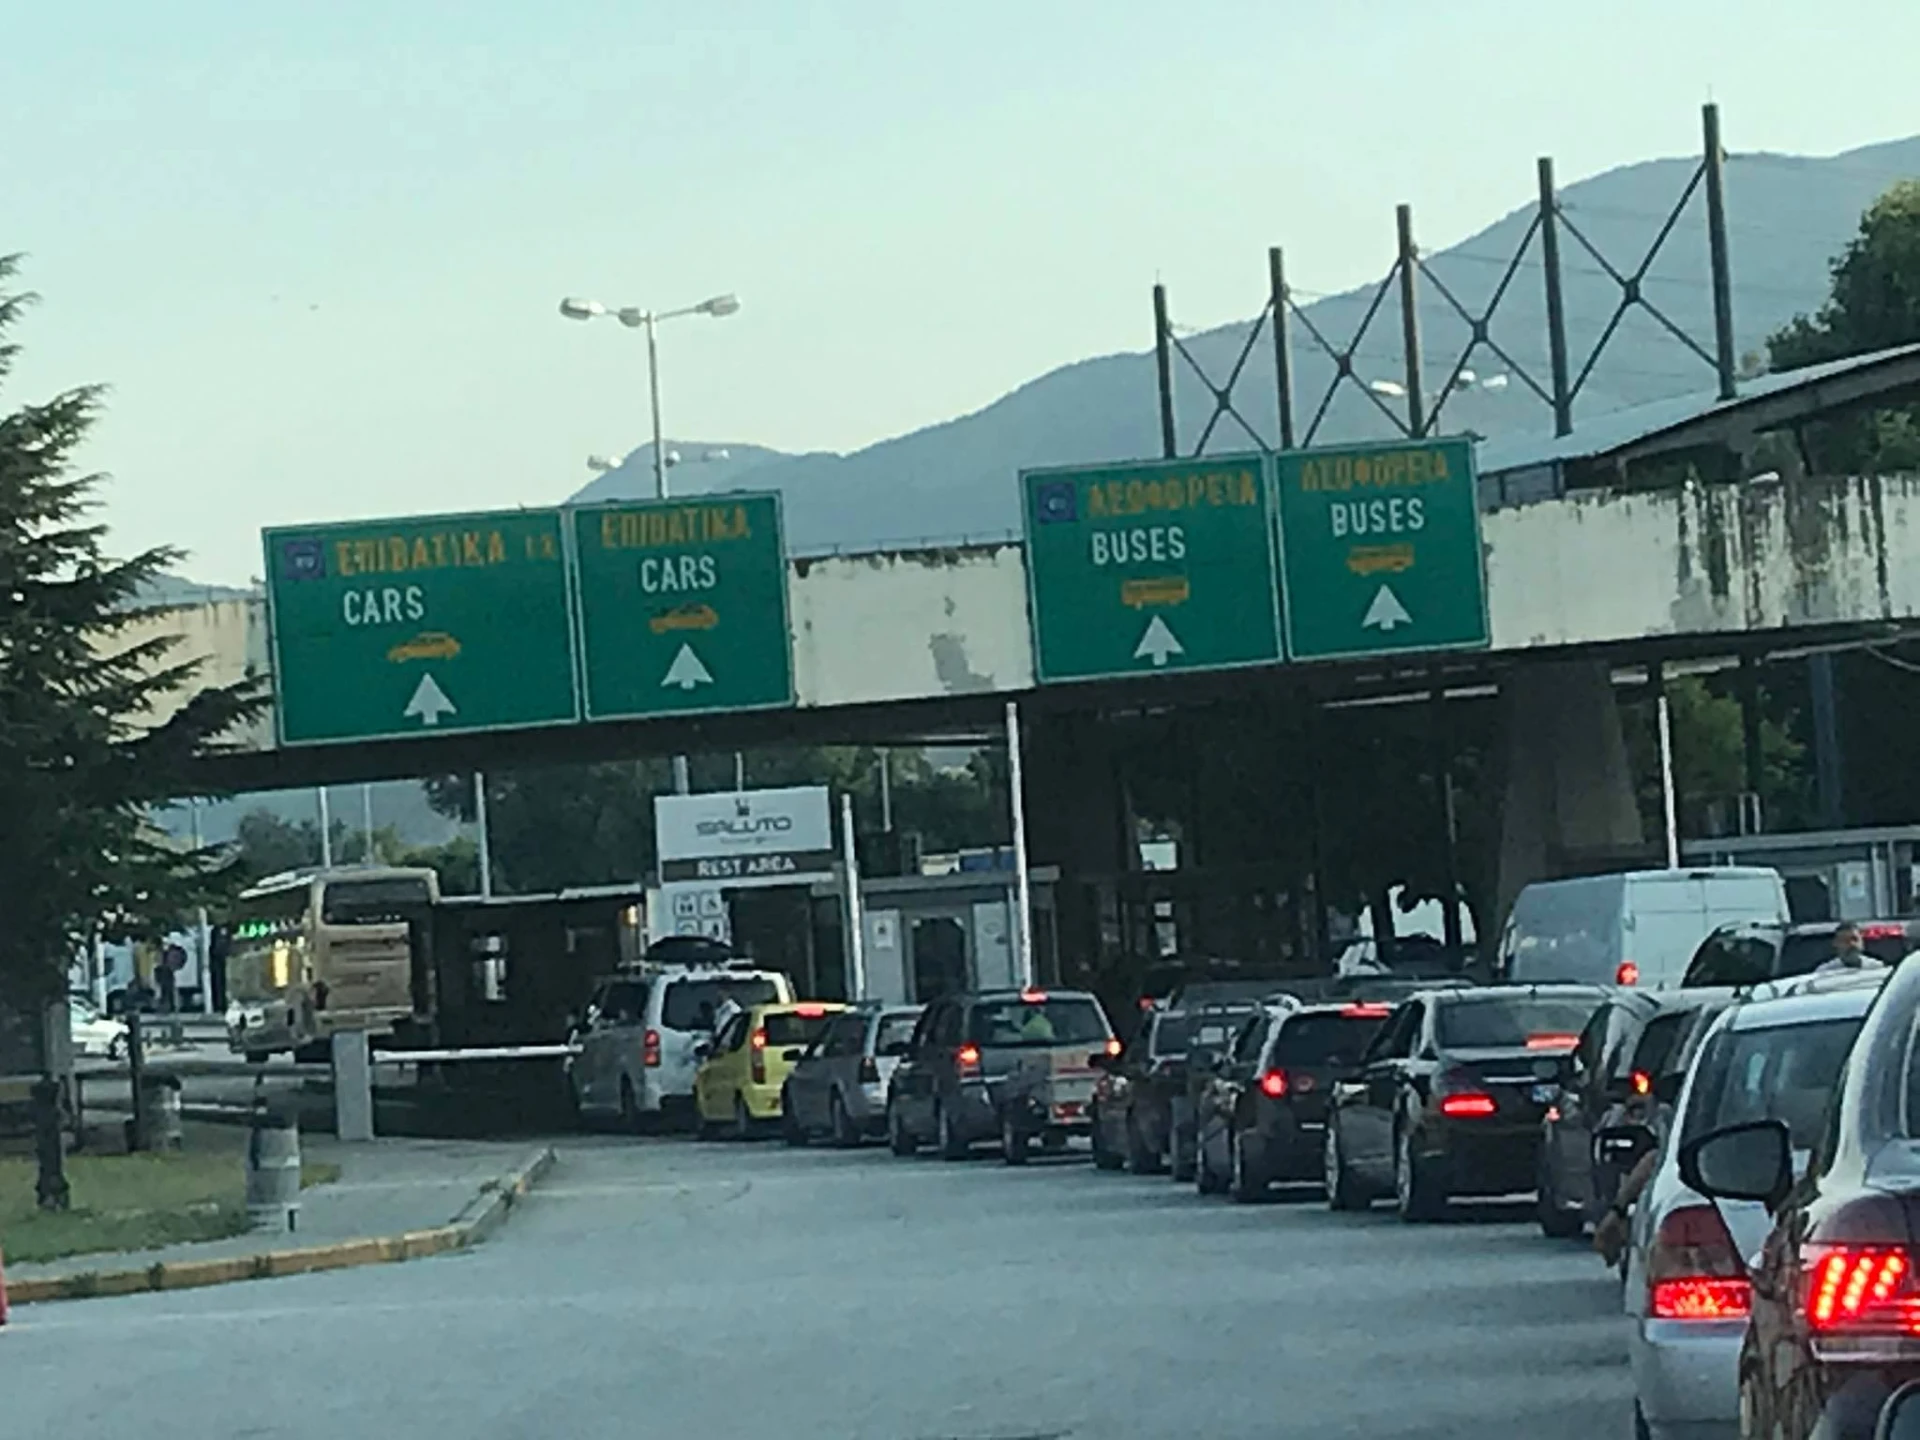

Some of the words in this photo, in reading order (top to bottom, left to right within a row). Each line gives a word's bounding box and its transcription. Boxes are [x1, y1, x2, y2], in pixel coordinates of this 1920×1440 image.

[1331, 497, 1425, 537] BUSES
[1091, 526, 1186, 565] BUSES
[641, 555, 717, 593] CARS
[343, 586, 424, 625] CARS
[697, 859, 743, 877] REST
[747, 855, 796, 873] AREA
